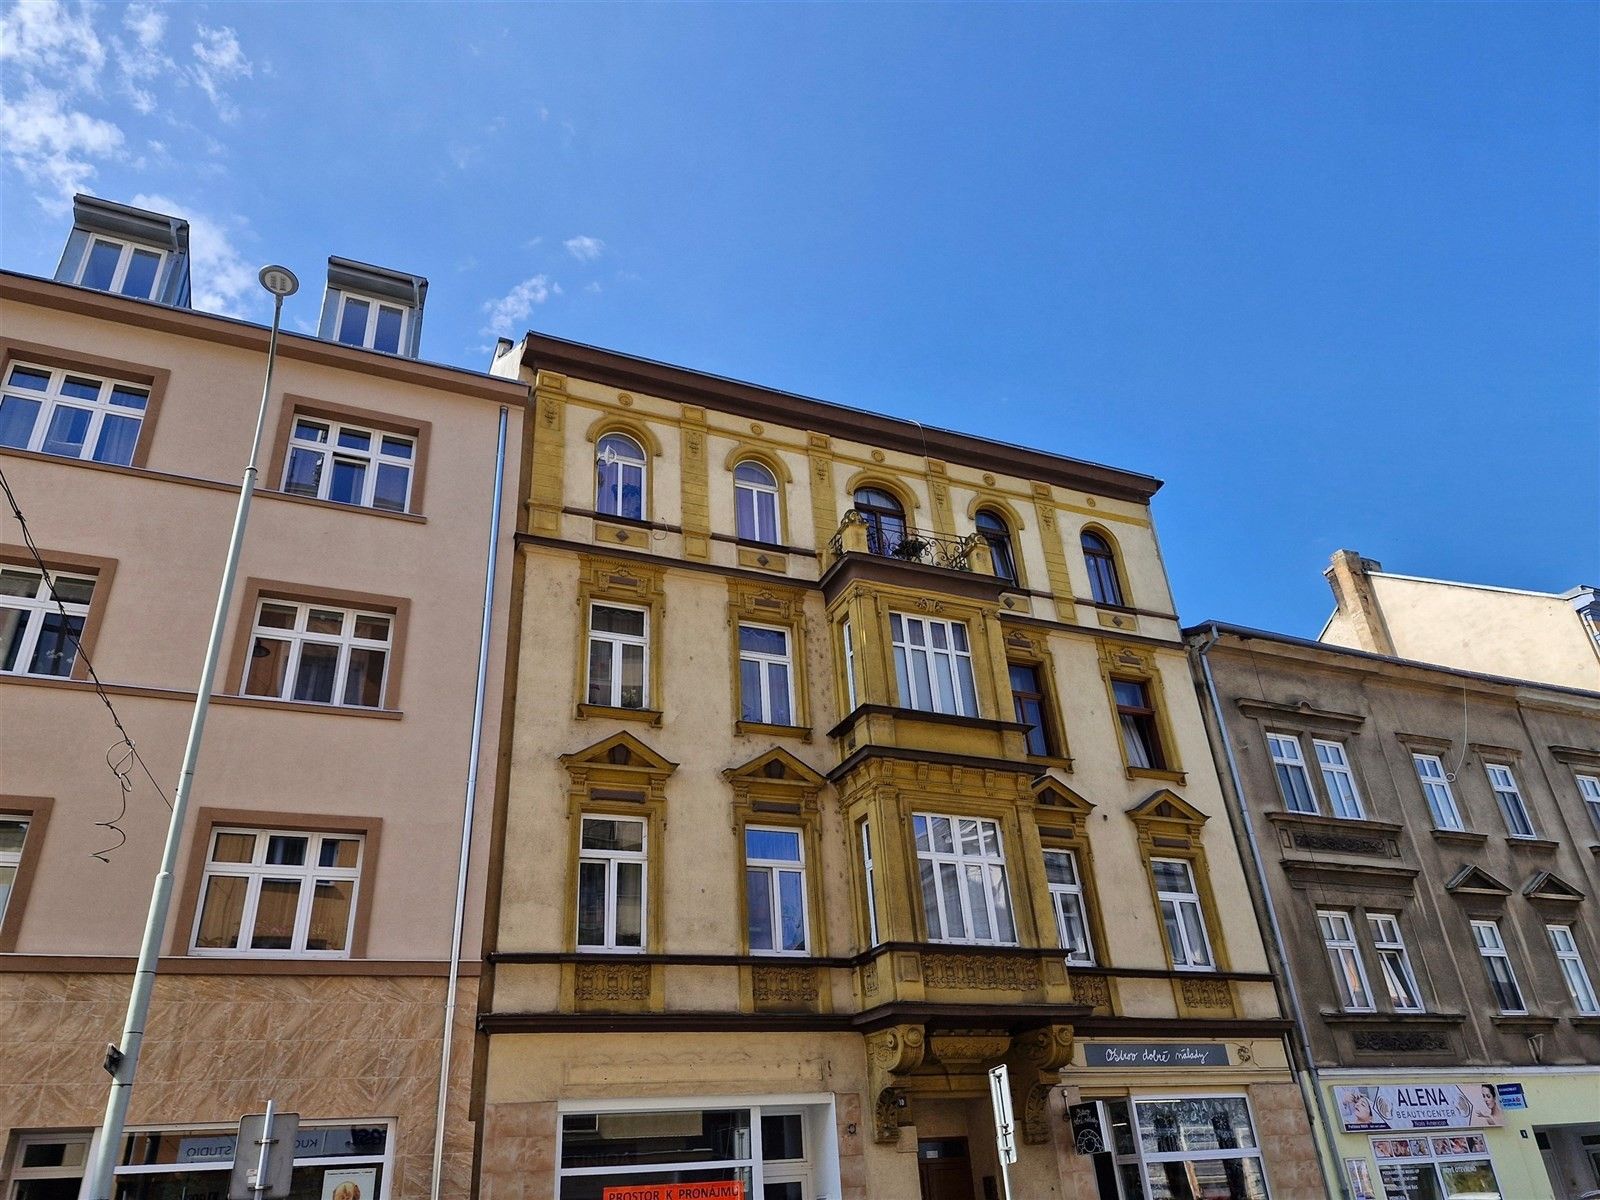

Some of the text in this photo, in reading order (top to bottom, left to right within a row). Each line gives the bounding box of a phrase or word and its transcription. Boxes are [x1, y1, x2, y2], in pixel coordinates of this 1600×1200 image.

[1397, 1088, 1450, 1107] ALENA
[608, 1184, 739, 1200] PROSTOR K PRONÁJMU
